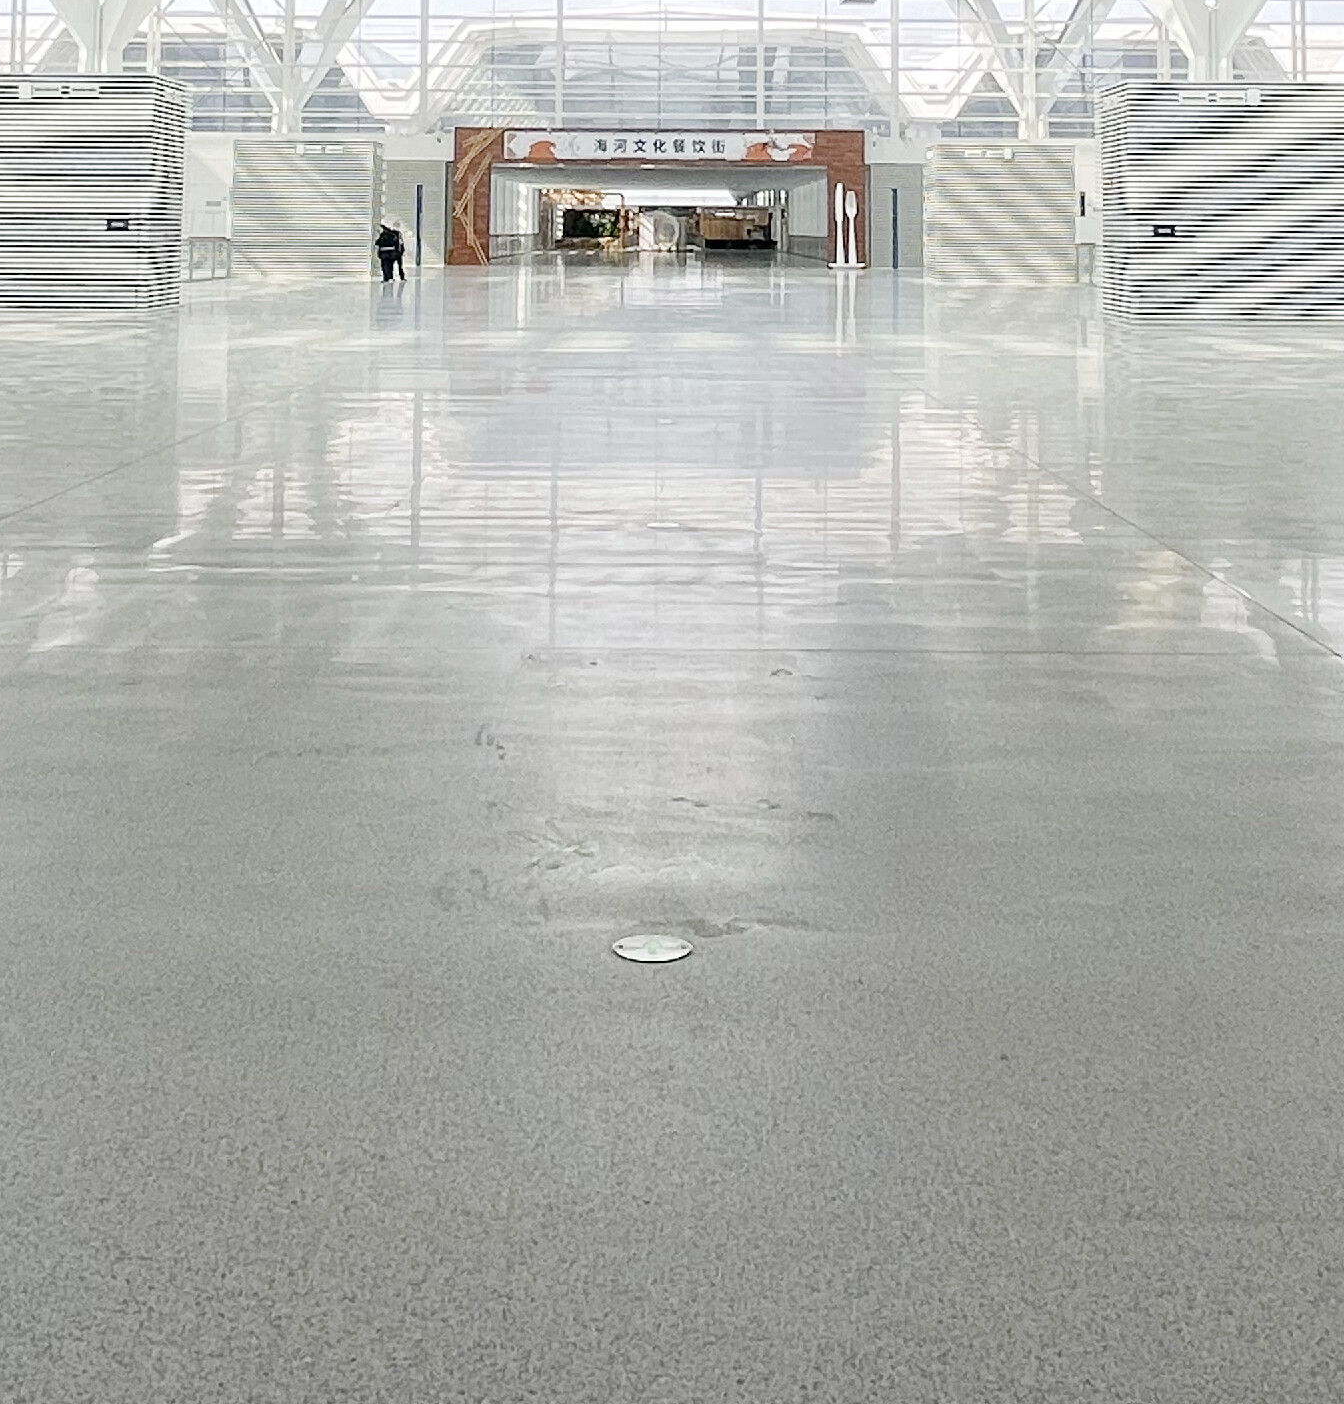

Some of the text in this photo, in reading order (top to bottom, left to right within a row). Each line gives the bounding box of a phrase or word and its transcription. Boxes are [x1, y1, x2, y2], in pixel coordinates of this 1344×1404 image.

[593, 138, 726, 155] 海河文化餐饮街
